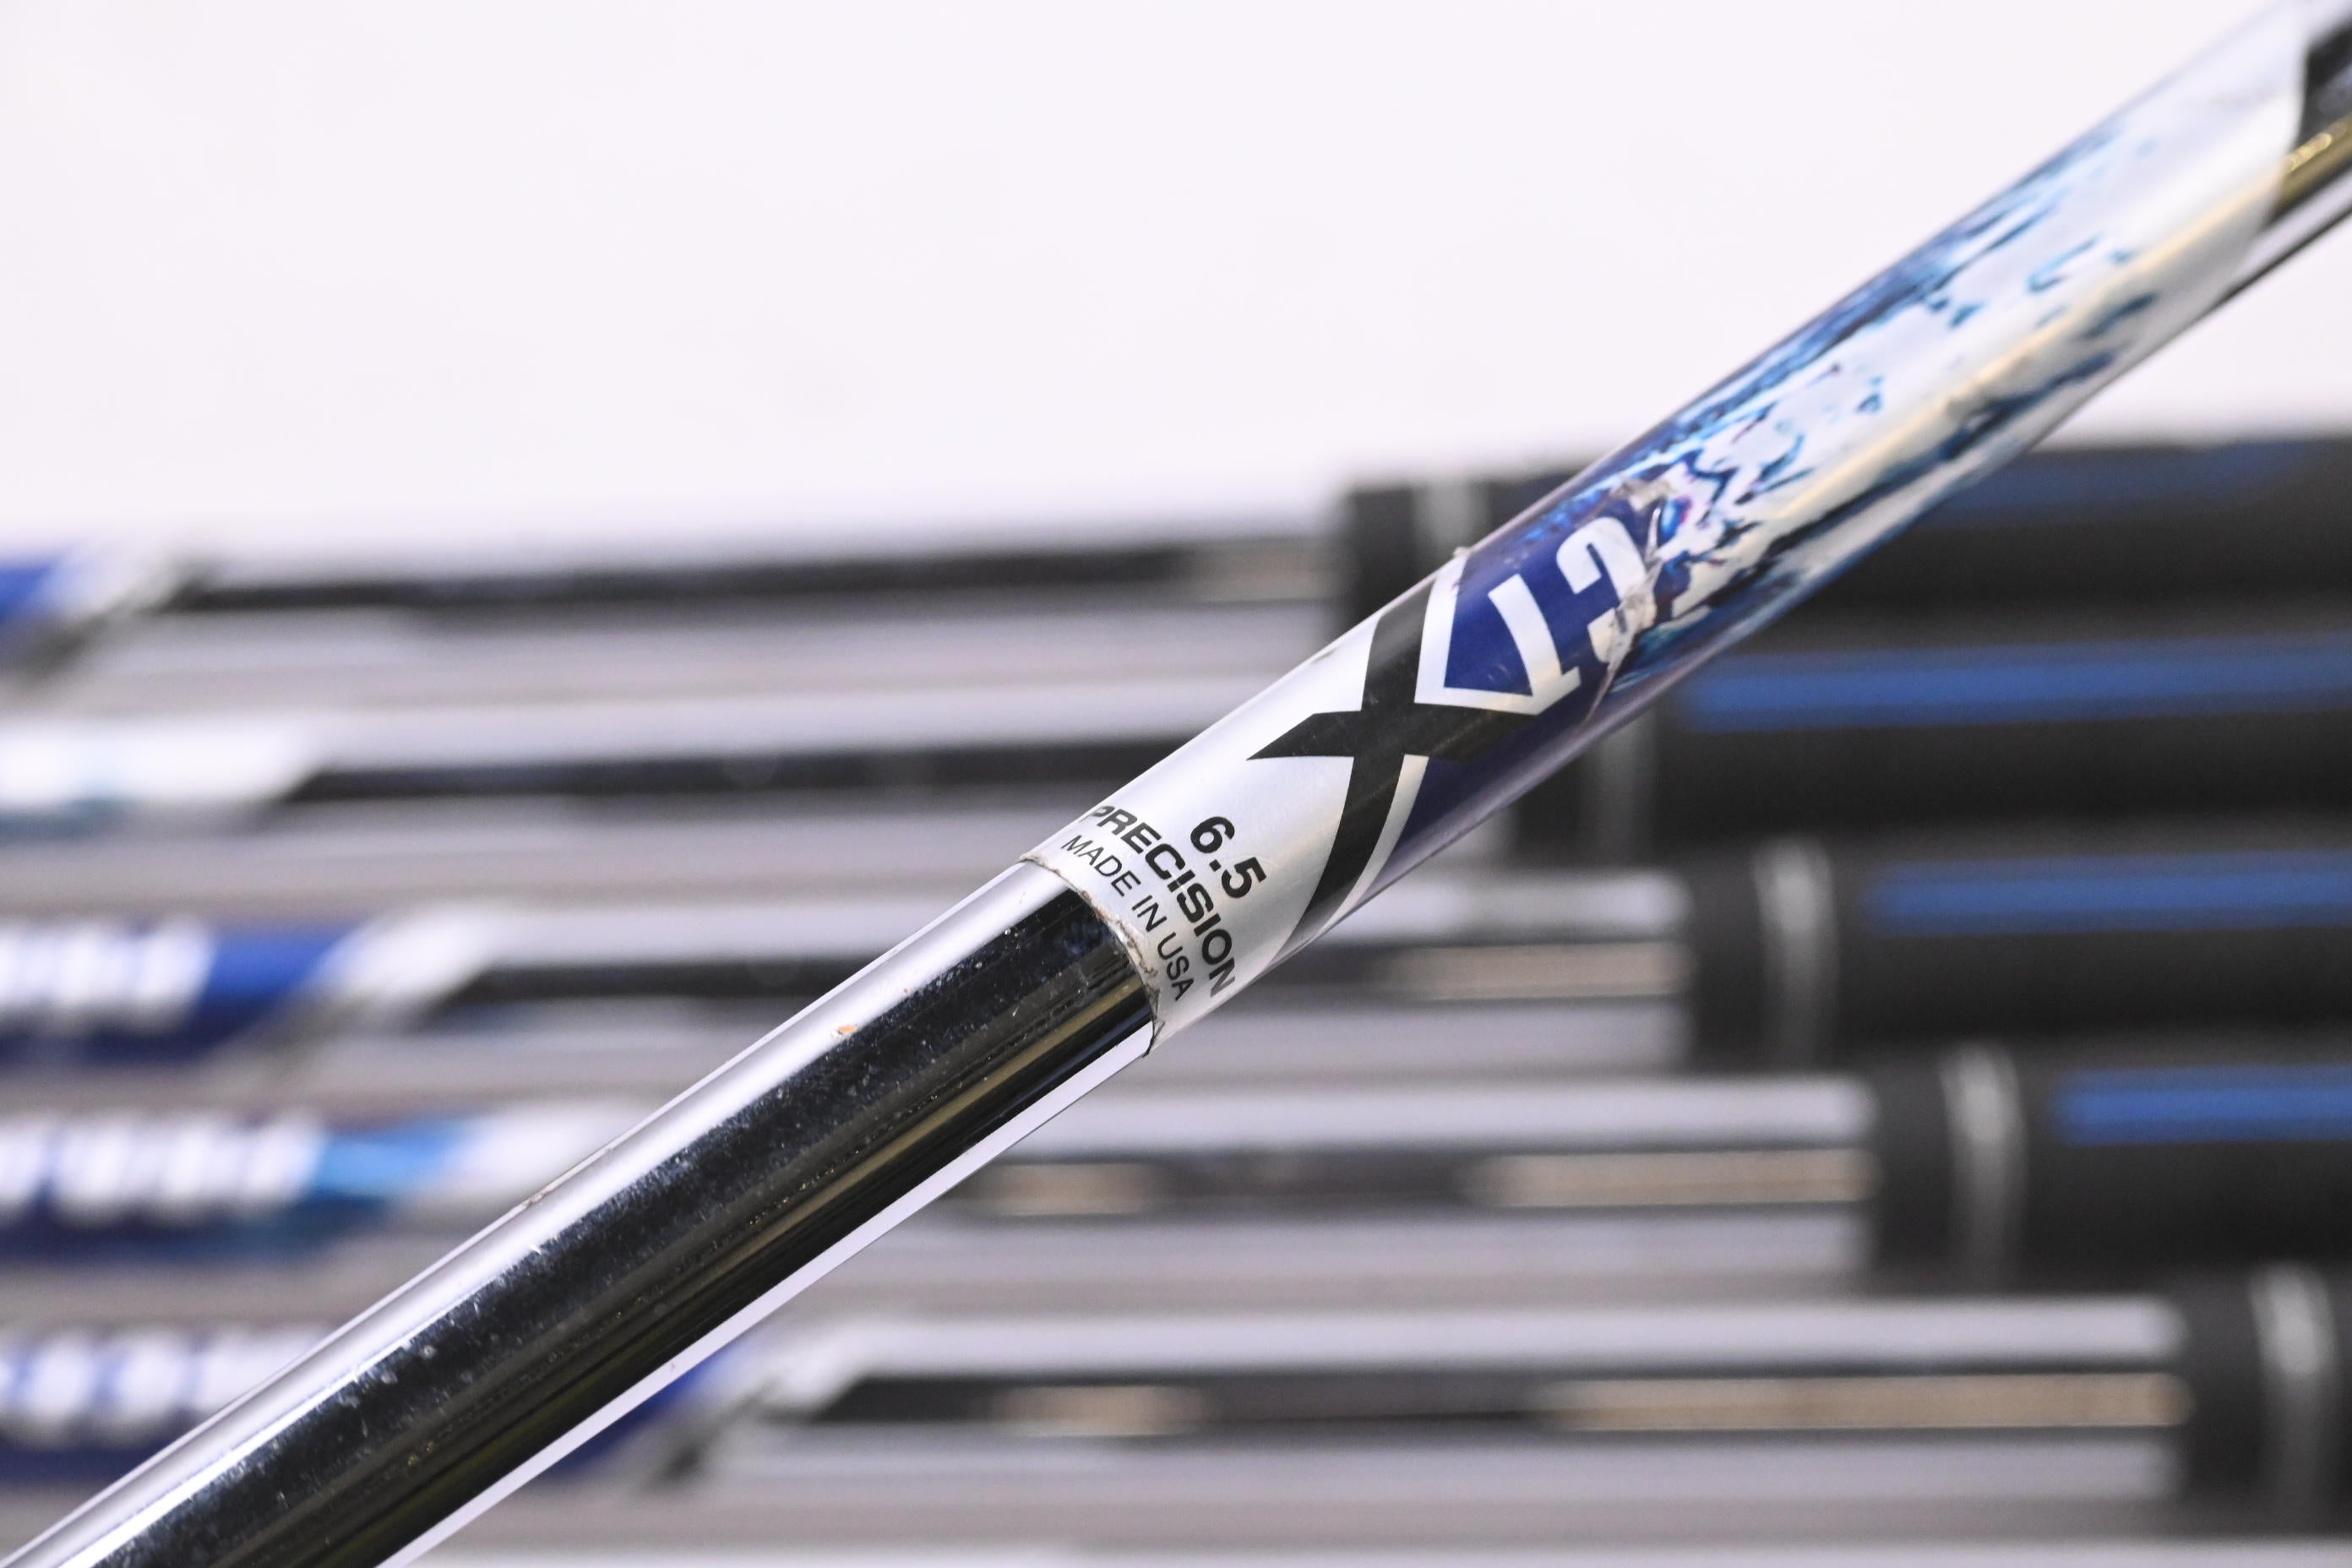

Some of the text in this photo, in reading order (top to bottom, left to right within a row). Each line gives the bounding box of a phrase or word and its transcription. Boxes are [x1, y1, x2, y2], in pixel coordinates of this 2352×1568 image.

[1061, 835, 1195, 1001] MADE IN USA
[1078, 805, 1236, 999] PRECISION
[1190, 816, 1266, 898] 6.5
